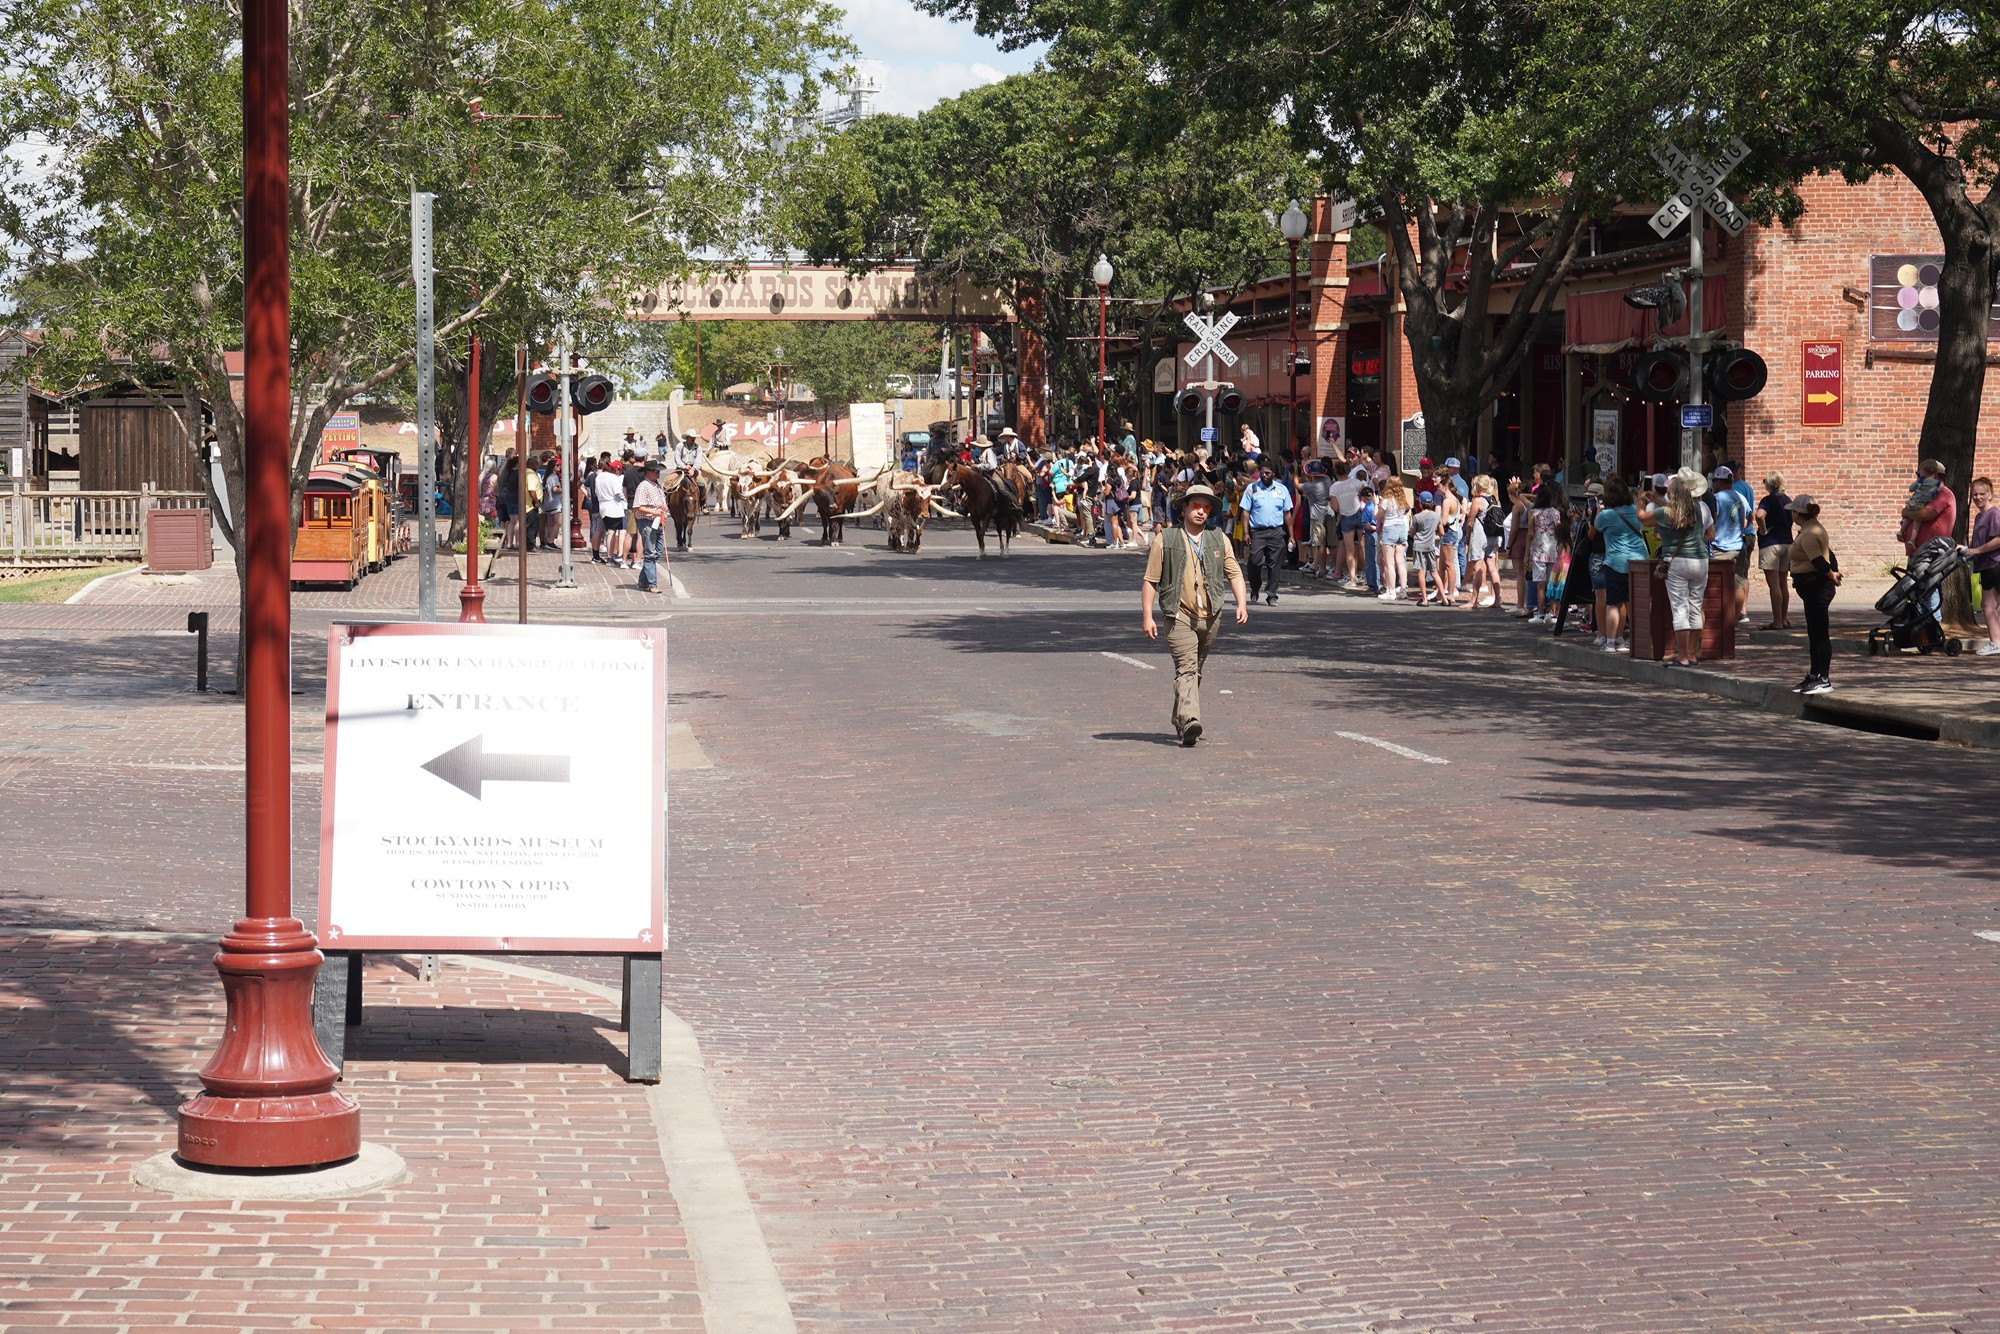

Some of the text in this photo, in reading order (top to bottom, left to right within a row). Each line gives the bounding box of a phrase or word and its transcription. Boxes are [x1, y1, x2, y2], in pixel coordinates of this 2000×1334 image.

[1657, 146, 1743, 229] CROSSING
[1704, 191, 1744, 231] ROAD
[825, 275, 941, 310] STATION
[1186, 314, 1236, 364] RAIL ROAD
[1189, 316, 1233, 363] CROSSING
[1805, 369, 1840, 379] PARKING
[323, 431, 356, 442] PETTING
[349, 656, 646, 672] LIVESTOCK EXCHANGE BUILDING
[404, 692, 580, 713] ENTRANCE
[381, 835, 604, 849] STOCKYARDS MUSEUM
[427, 849, 469, 857] MONDAY
[410, 878, 576, 892] COWTOWN OPRY
[456, 901, 491, 910] INSIDE
